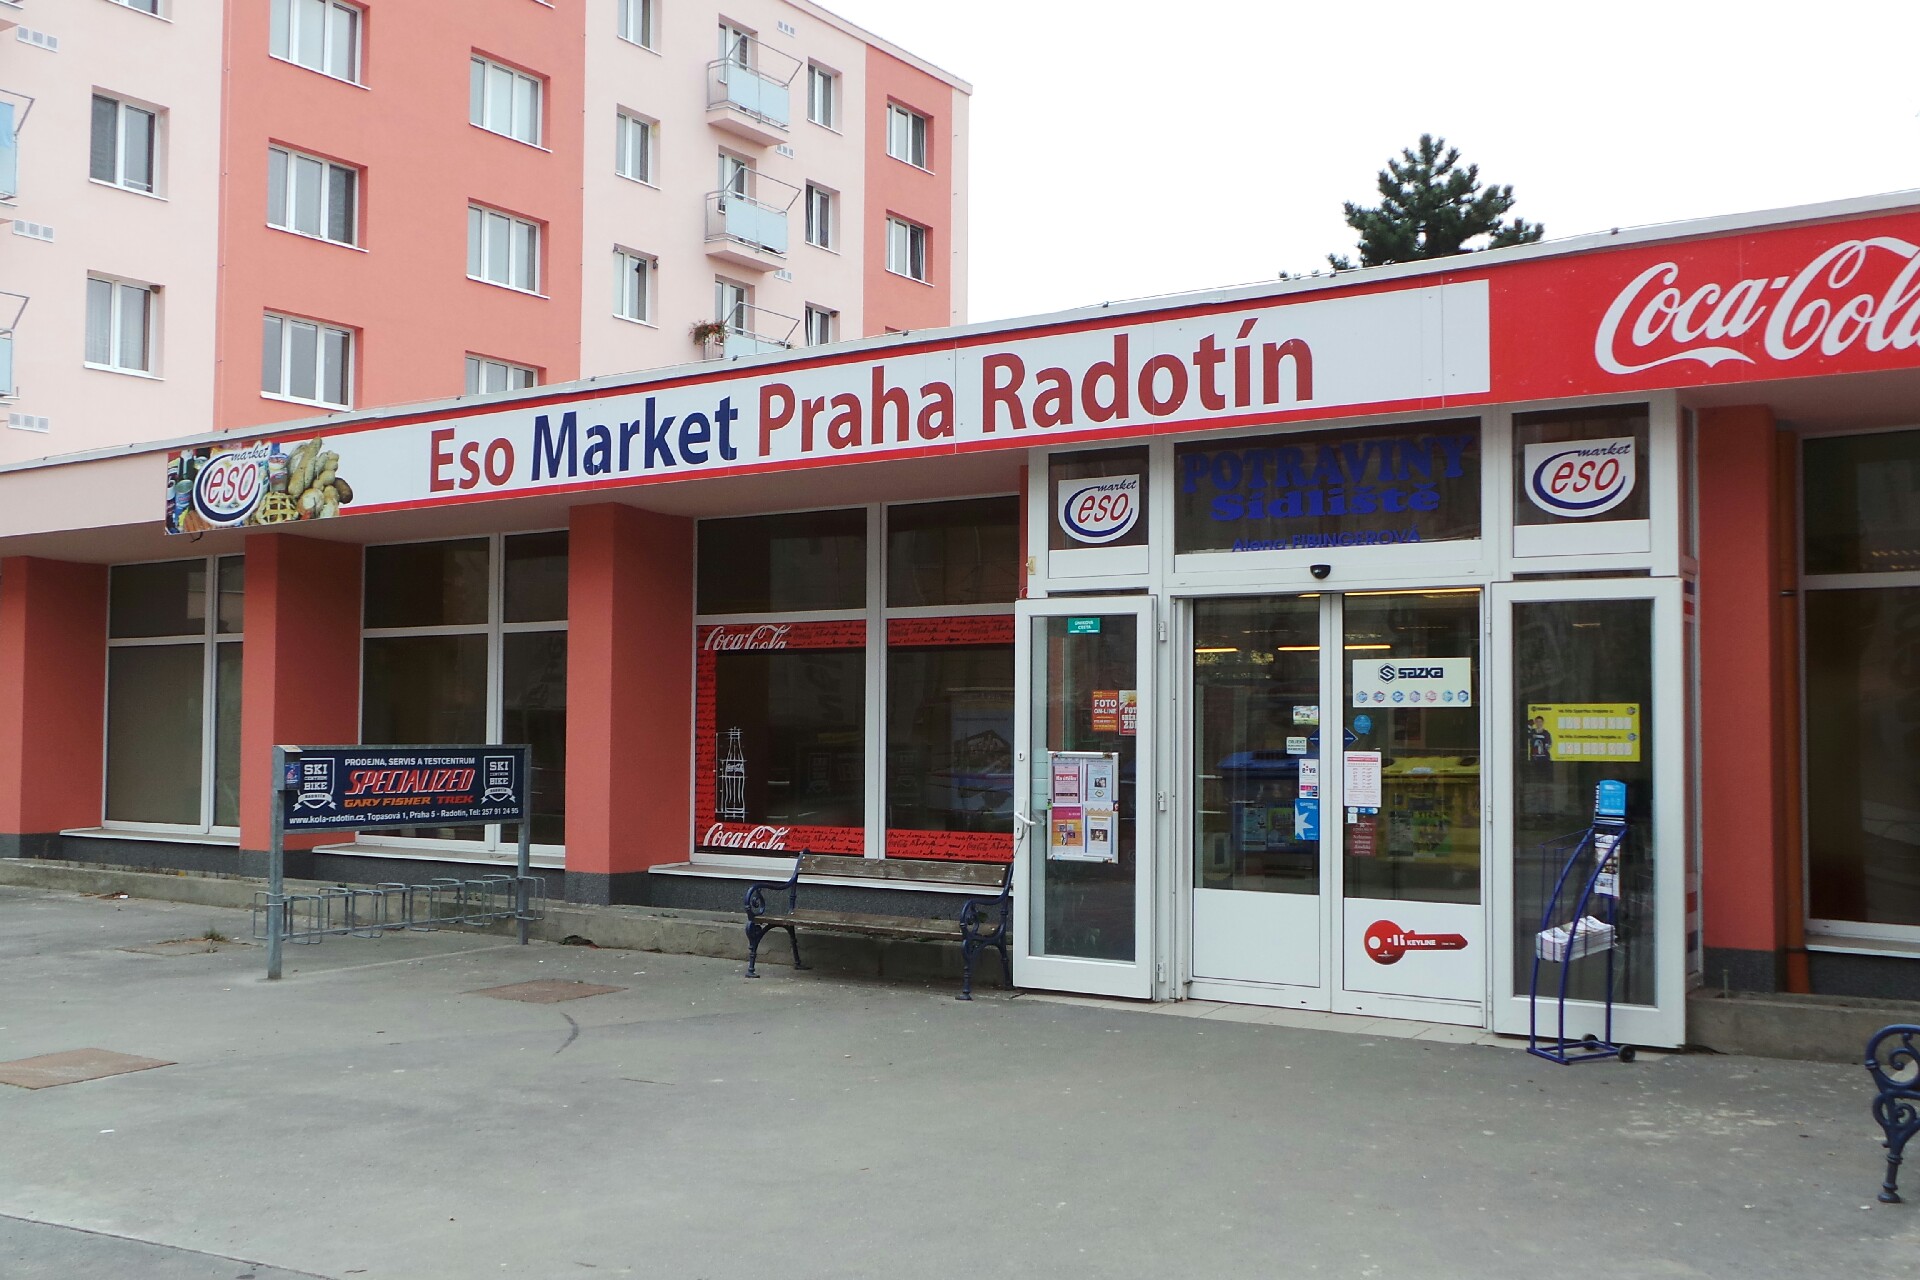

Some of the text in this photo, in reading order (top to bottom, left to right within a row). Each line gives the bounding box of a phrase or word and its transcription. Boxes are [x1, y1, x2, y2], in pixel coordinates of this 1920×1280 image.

[430, 317, 1313, 492] Eso Market Praha Radotín
[230, 443, 270, 462] market
[1577, 442, 1631, 457] market
[1182, 435, 1474, 493] POTRAVINY
[1551, 458, 1620, 494] eso
[207, 463, 256, 504] eso
[1097, 478, 1137, 492] market
[1077, 493, 1129, 524] eso
[1231, 537, 1286, 553] Alena
[1094, 699, 1117, 708] FOTO
[344, 757, 475, 766] PRODEJNA, SERVIS A TESTCENTRUM
[489, 761, 509, 771] SKI
[304, 763, 328, 775] SKI
[303, 781, 328, 790] BIKE
[344, 767, 476, 795] SPECIALIZED
[489, 777, 509, 785] BIKE
[344, 795, 474, 808] GARY FISHER TREK
[409, 810, 430, 819] Praha
[431, 810, 436, 818] 5
[503, 807, 510, 815] 24
